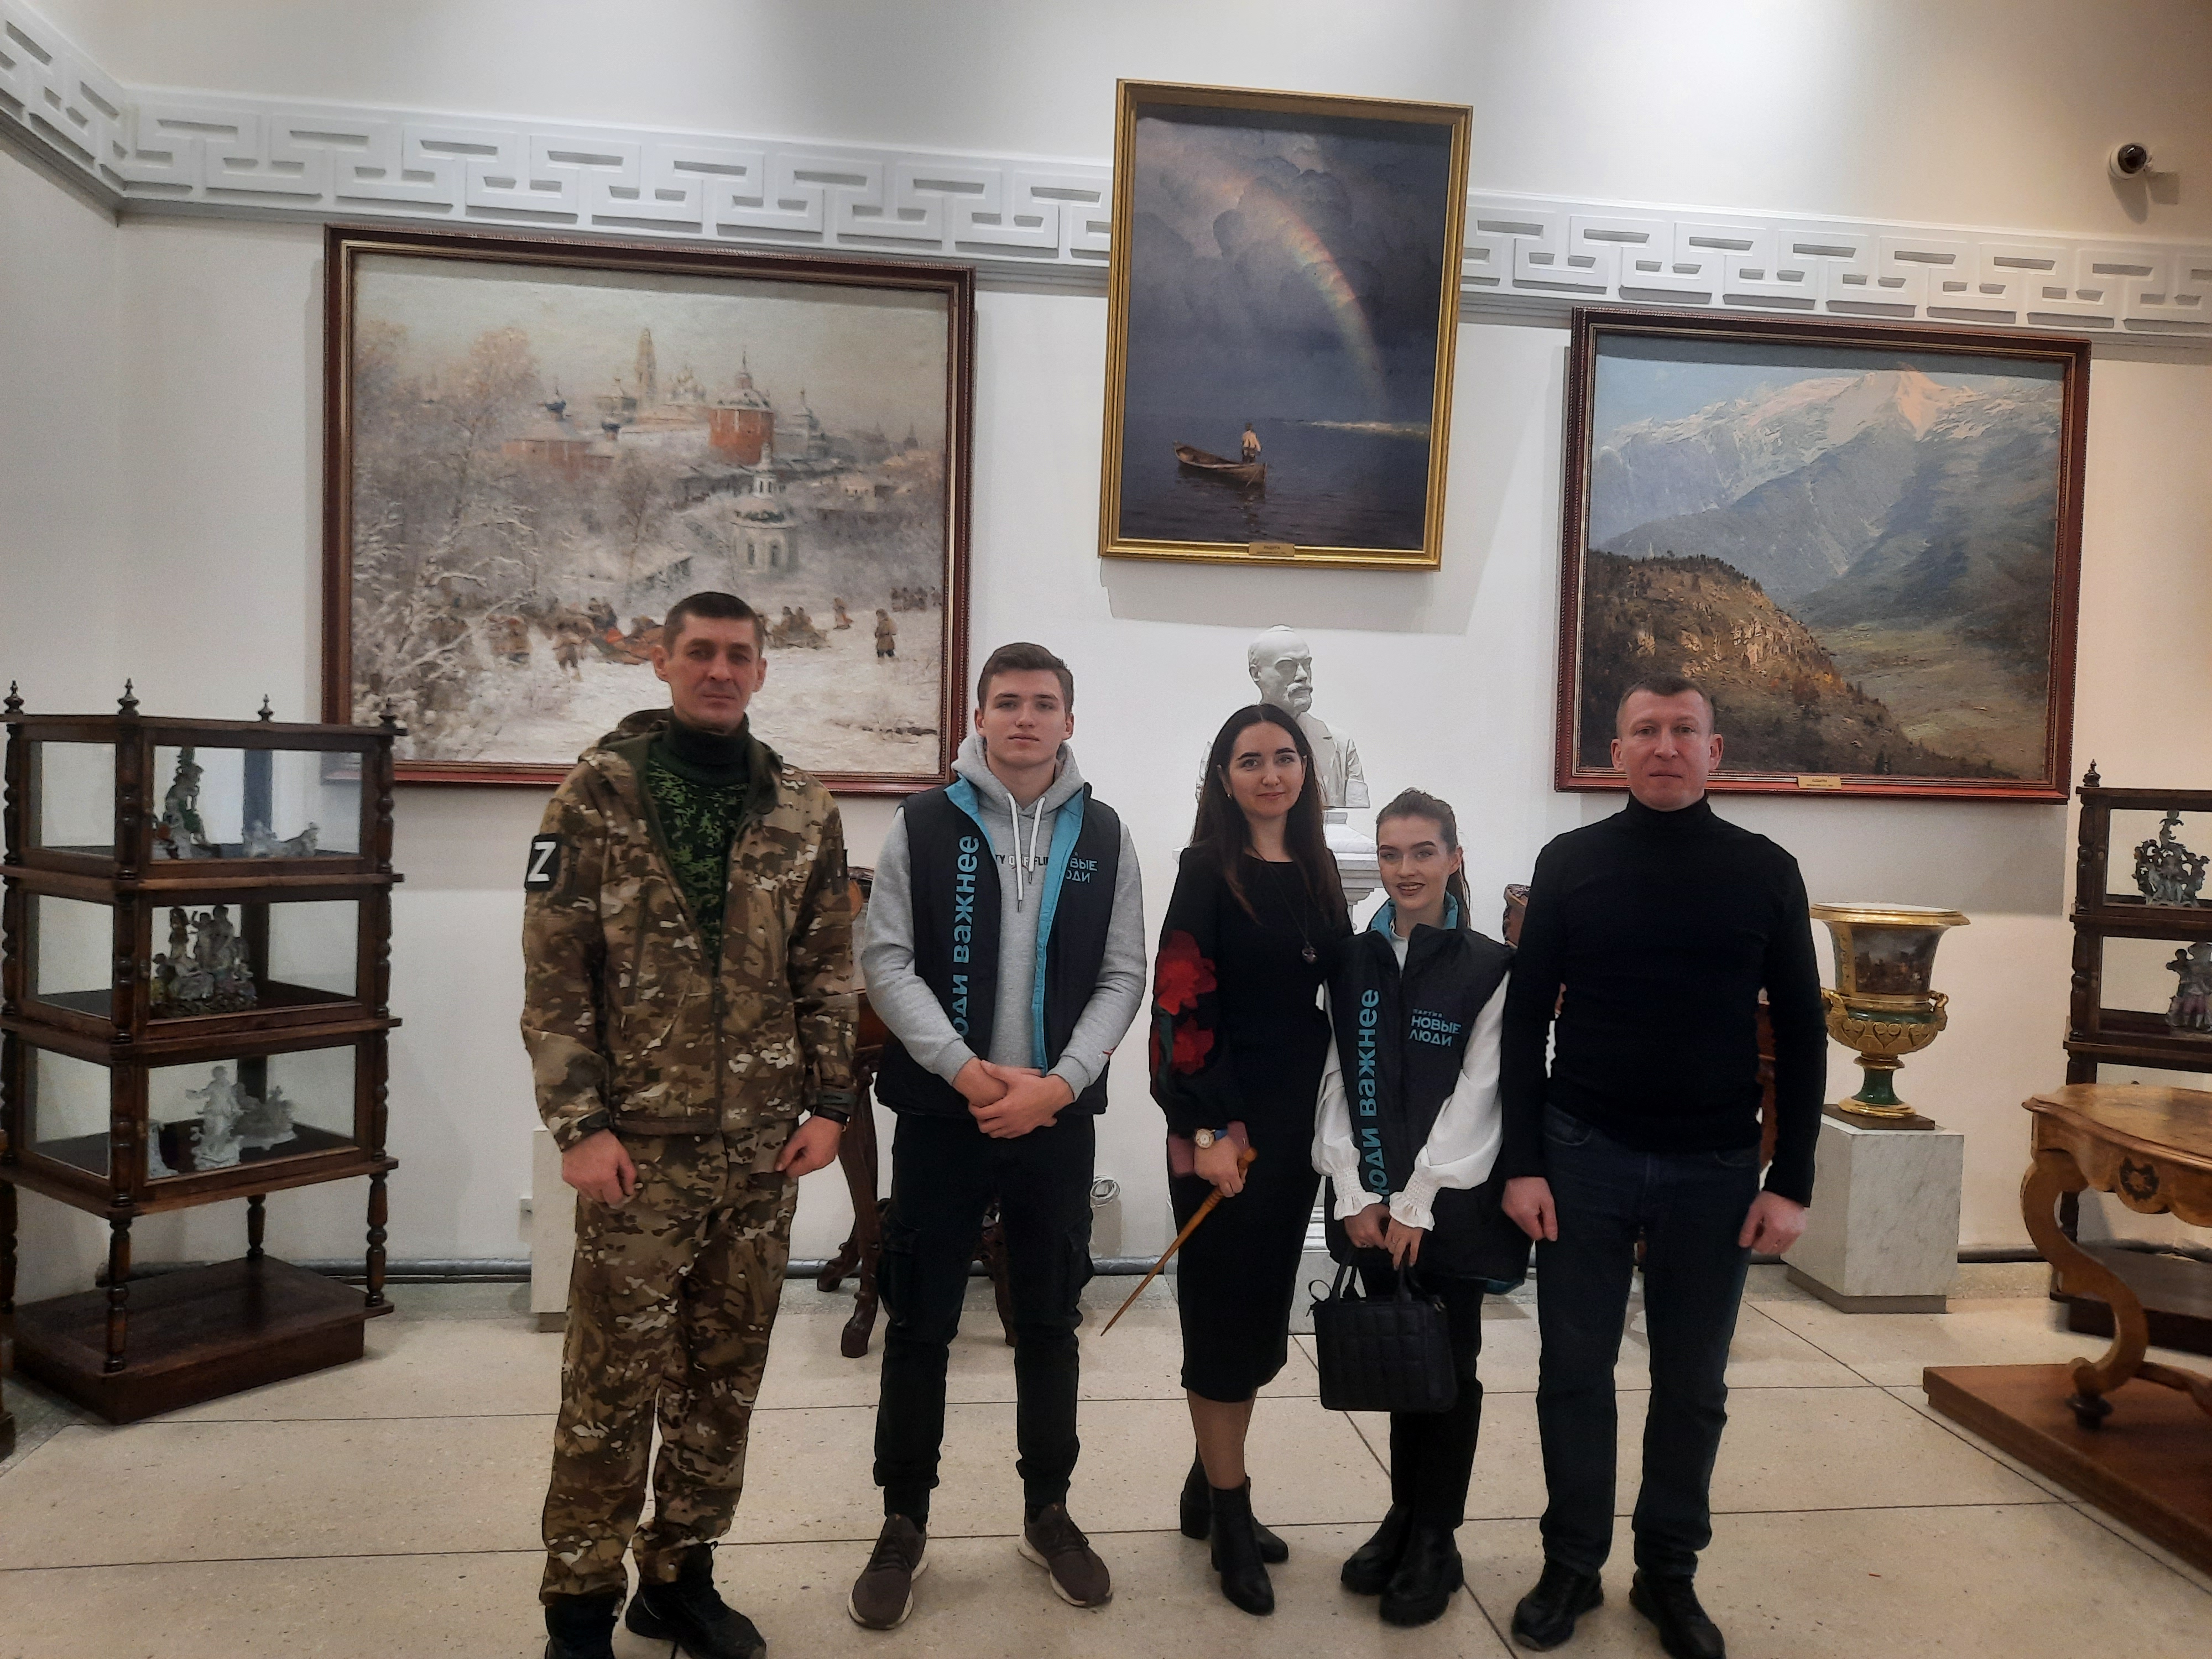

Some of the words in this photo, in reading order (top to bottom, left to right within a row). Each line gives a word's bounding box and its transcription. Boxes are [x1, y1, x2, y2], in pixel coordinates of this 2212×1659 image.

[527, 841, 557, 882] Z
[1070, 857, 1098, 872] ВЫЕ
[953, 836, 979, 963] важнее
[1408, 1029, 1453, 1047] ЛЮДИ
[1411, 1015, 1462, 1034] НОВЫЕ
[1358, 989, 1379, 1117] важнее
[1361, 1128, 1390, 1196] юди
